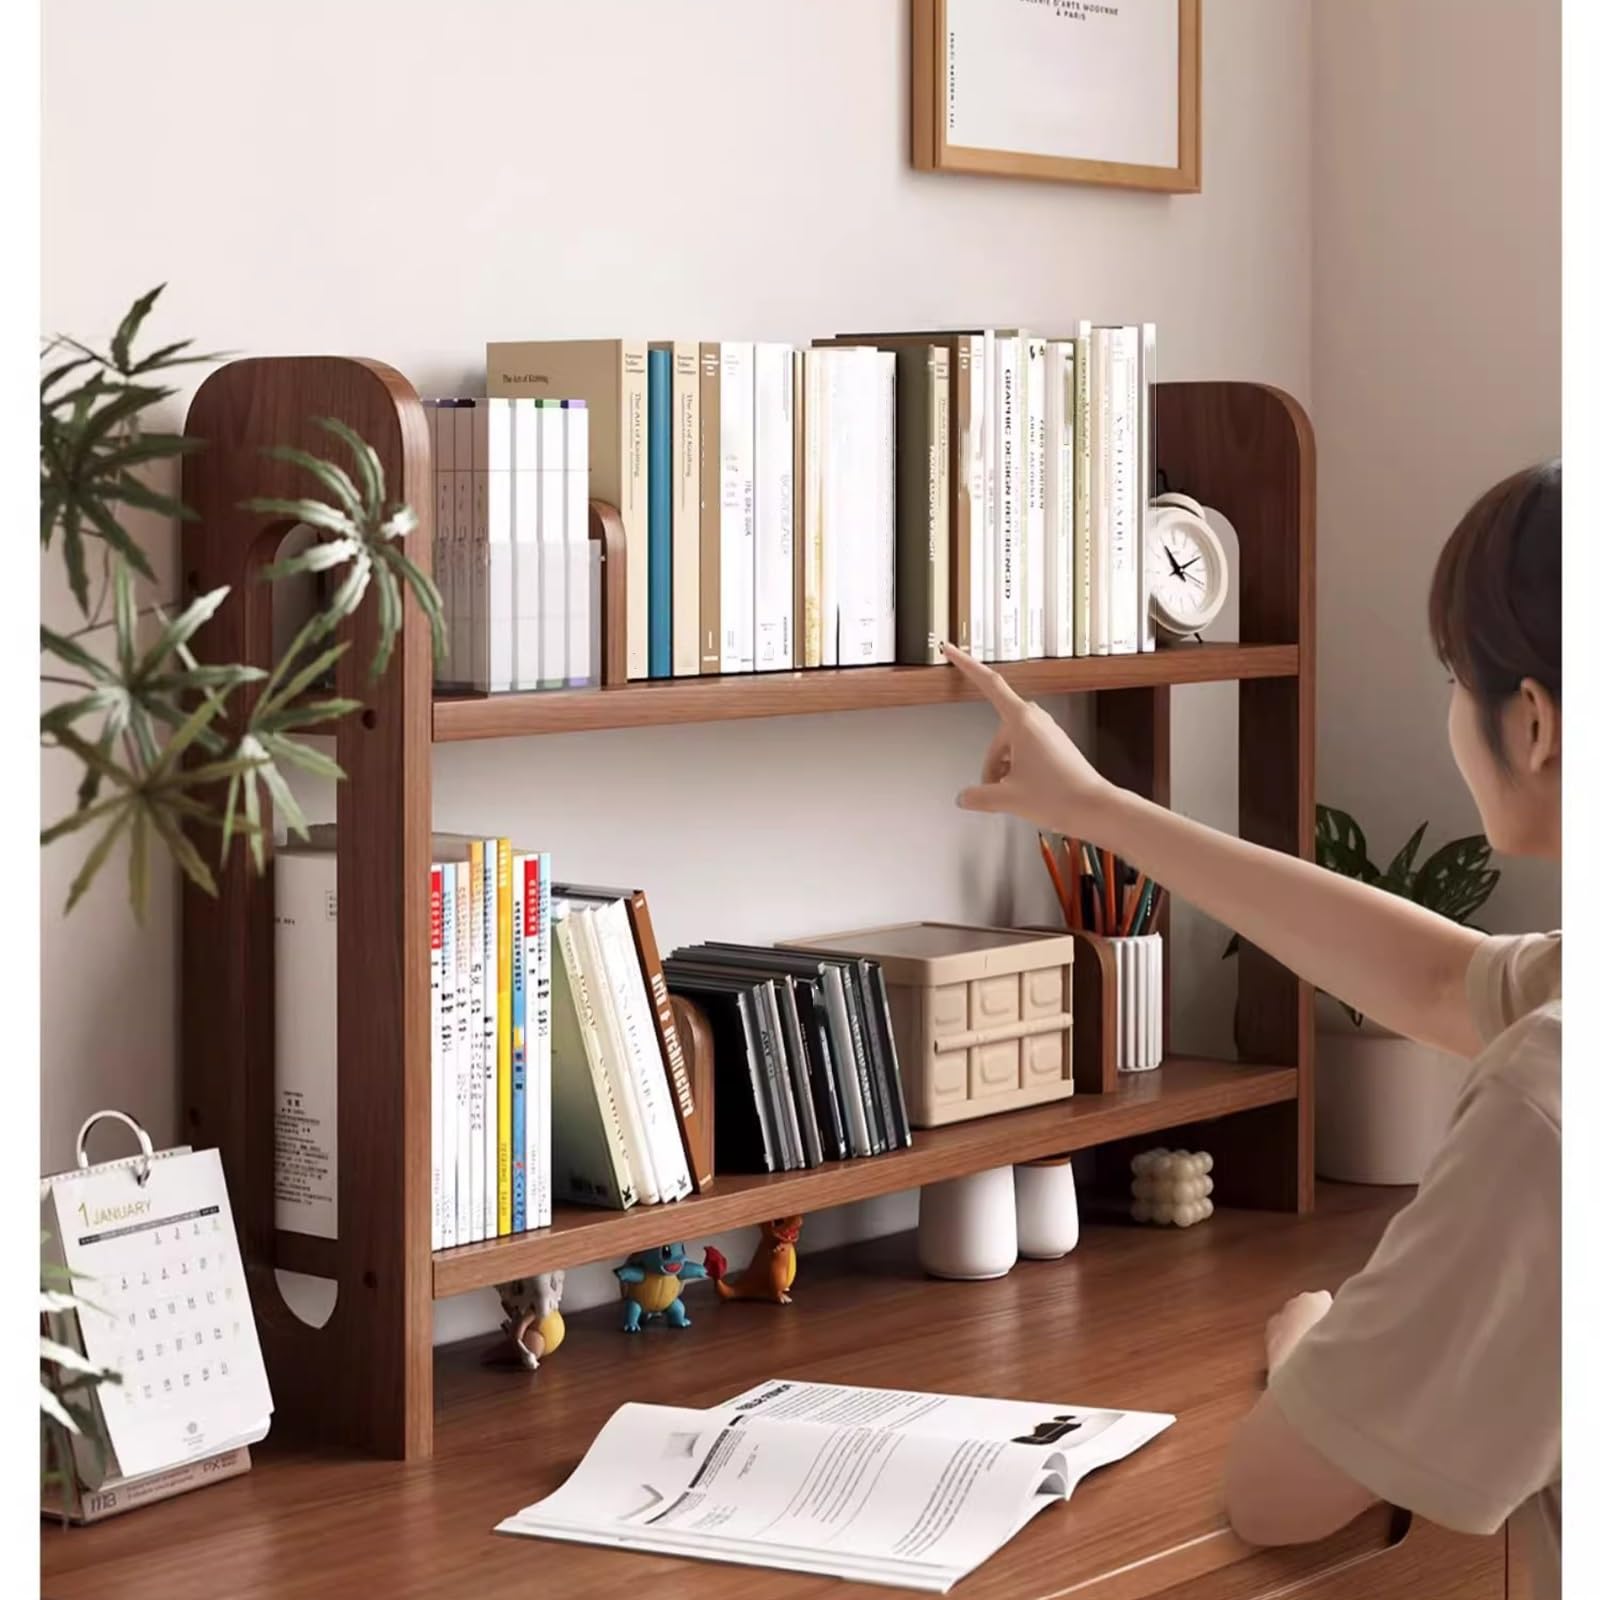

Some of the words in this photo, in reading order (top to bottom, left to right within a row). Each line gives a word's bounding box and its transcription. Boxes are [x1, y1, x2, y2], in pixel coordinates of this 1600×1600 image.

[1064, 10, 1086, 21] PARIS
[1004, 440, 1013, 496] DESIGN
[78, 1202, 89, 1227] 1
[93, 1200, 152, 1225] JANUARY
